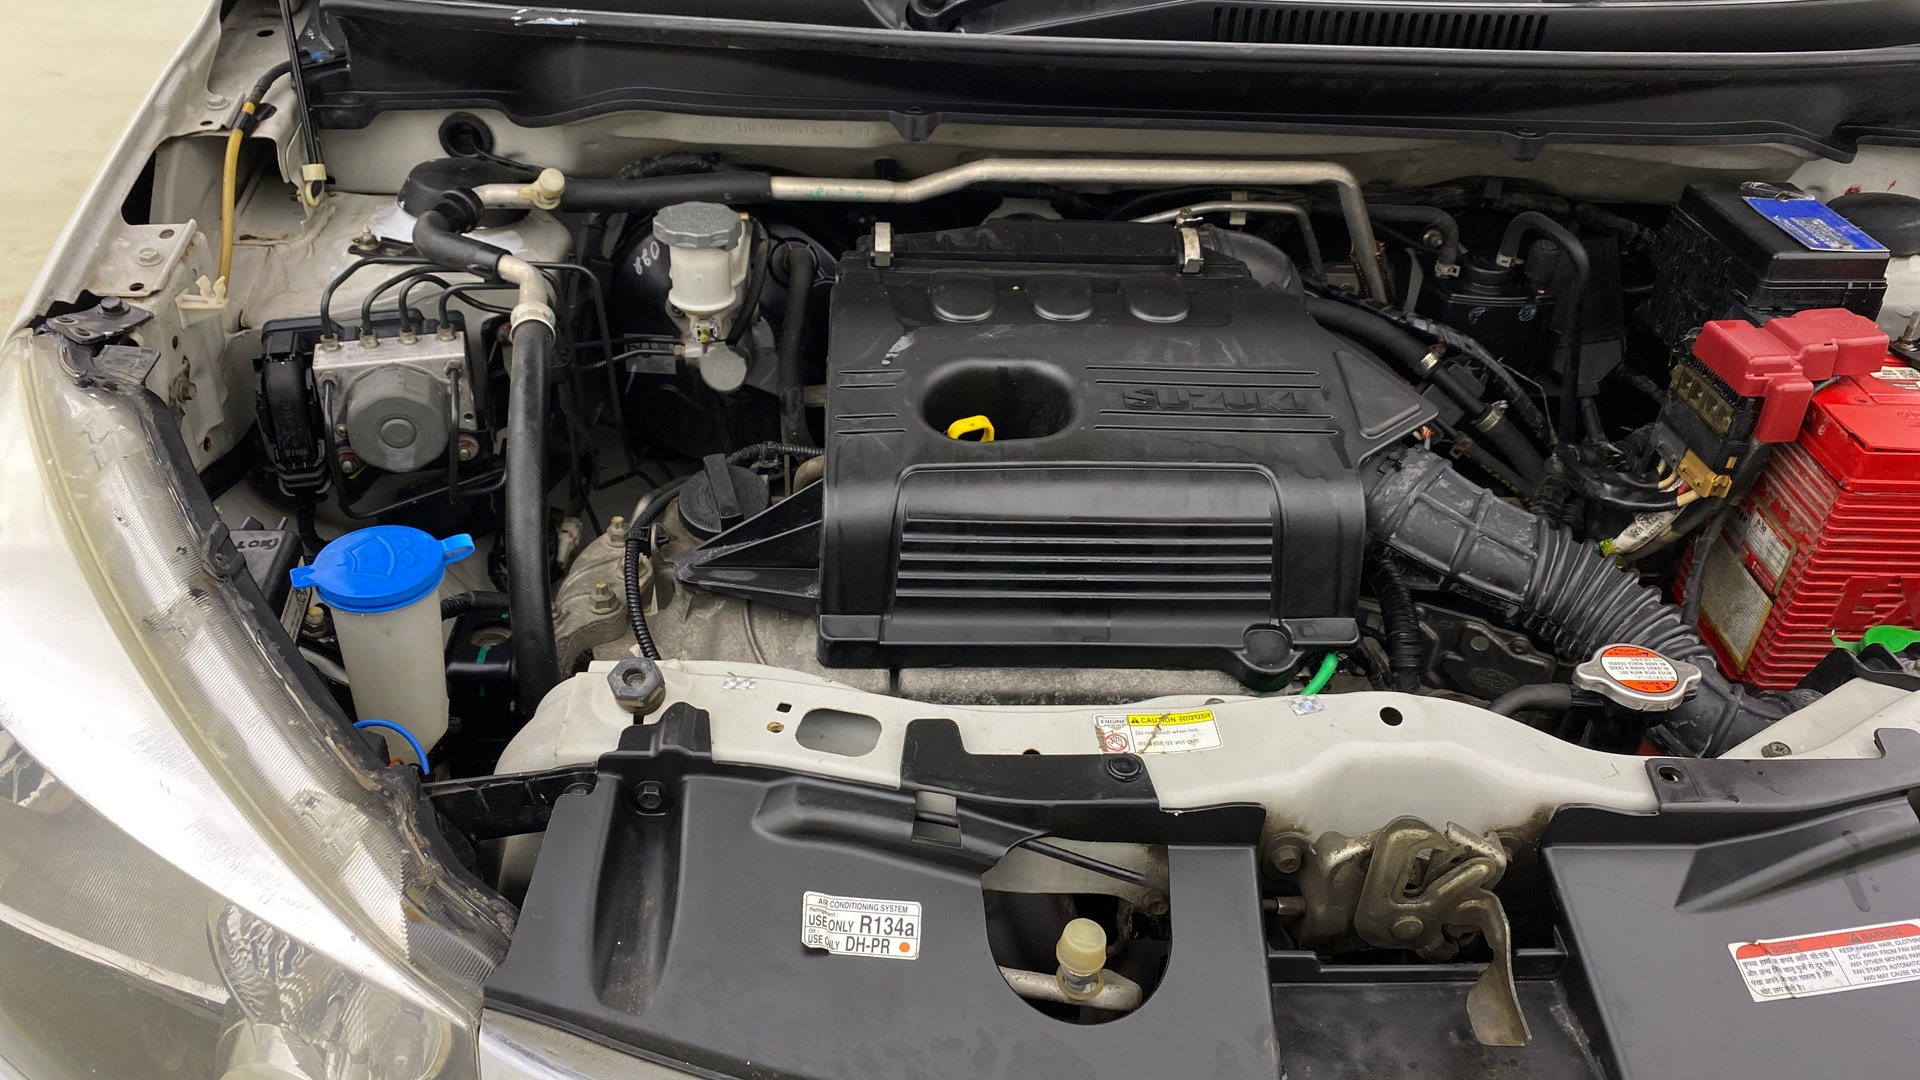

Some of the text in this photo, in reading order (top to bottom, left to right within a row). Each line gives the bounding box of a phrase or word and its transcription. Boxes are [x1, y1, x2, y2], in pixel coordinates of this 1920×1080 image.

[1121, 388, 1308, 412] SUZUKI
[818, 898, 908, 913] AIR CONDITIONING SYSTEM
[808, 914, 914, 937] USE ONLY R134a
[1859, 929, 1902, 940] WARNING
[808, 934, 823, 944] USE
[845, 935, 890, 954] DH-PR
[1863, 957, 1885, 966] OTHER
[1884, 954, 1908, 963] MOVING
[1865, 965, 1888, 973] STARTS
[1890, 969, 1911, 977] CAUSE
